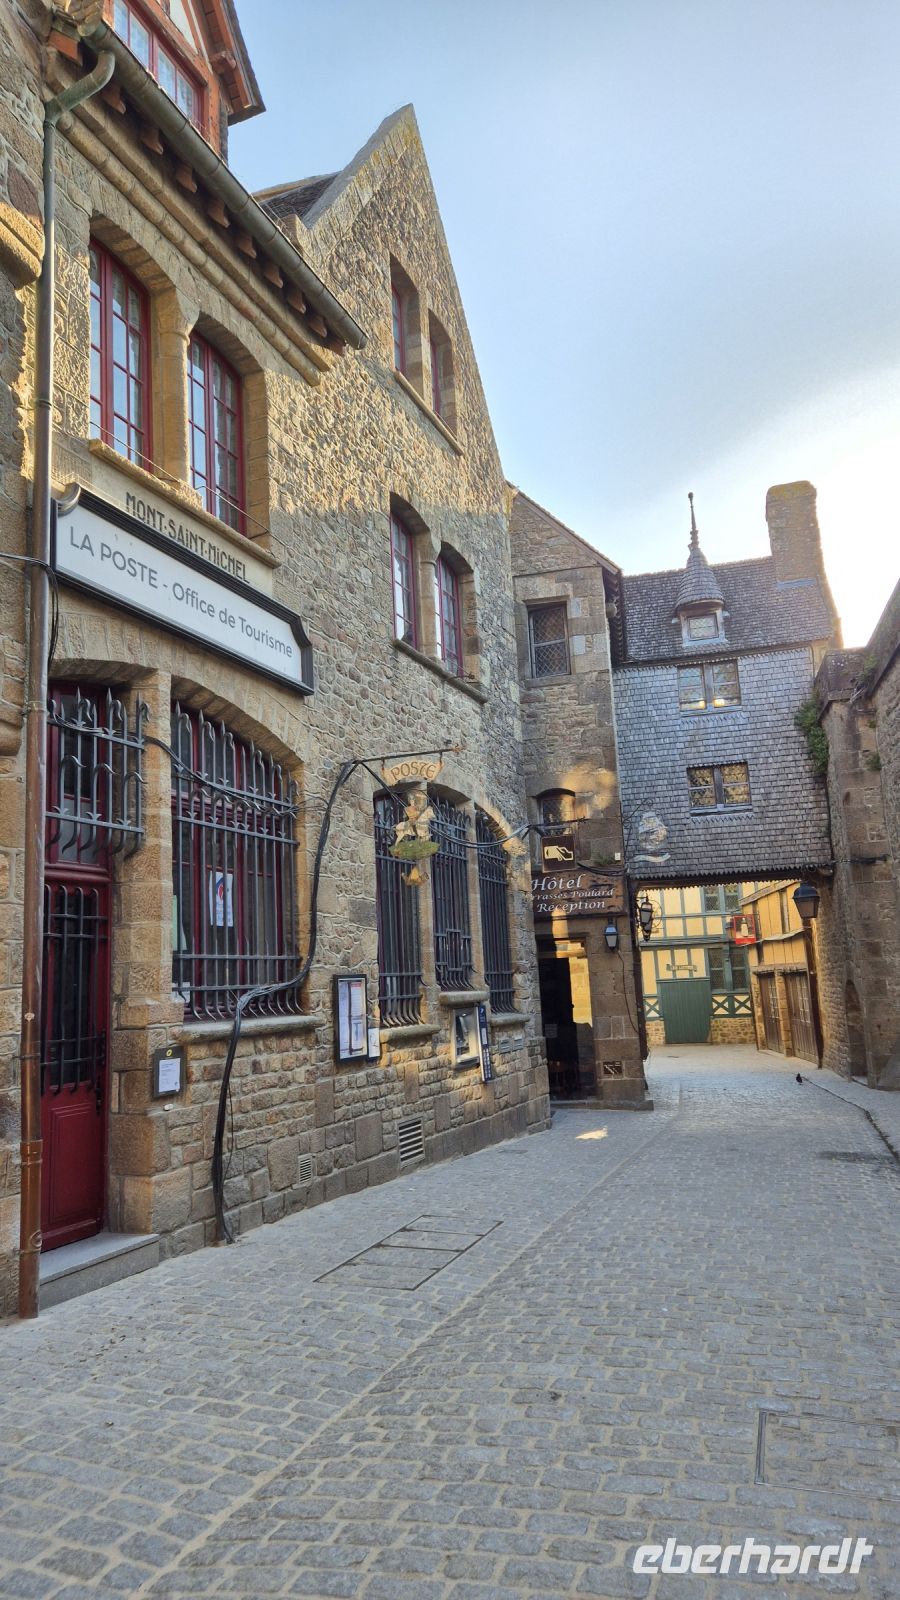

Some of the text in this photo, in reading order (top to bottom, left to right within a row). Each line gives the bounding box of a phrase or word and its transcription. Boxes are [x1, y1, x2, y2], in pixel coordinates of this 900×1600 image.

[69, 525, 95, 558] LA
[100, 542, 159, 589] POSTE
[172, 582, 215, 618] Office
[218, 607, 236, 629] de
[238, 615, 293, 659] Tourisme
[390, 761, 436, 780] POSTE
[532, 873, 586, 891] Hôtel
[532, 887, 615, 900] rasses Poulard
[536, 900, 606, 914] Réception
